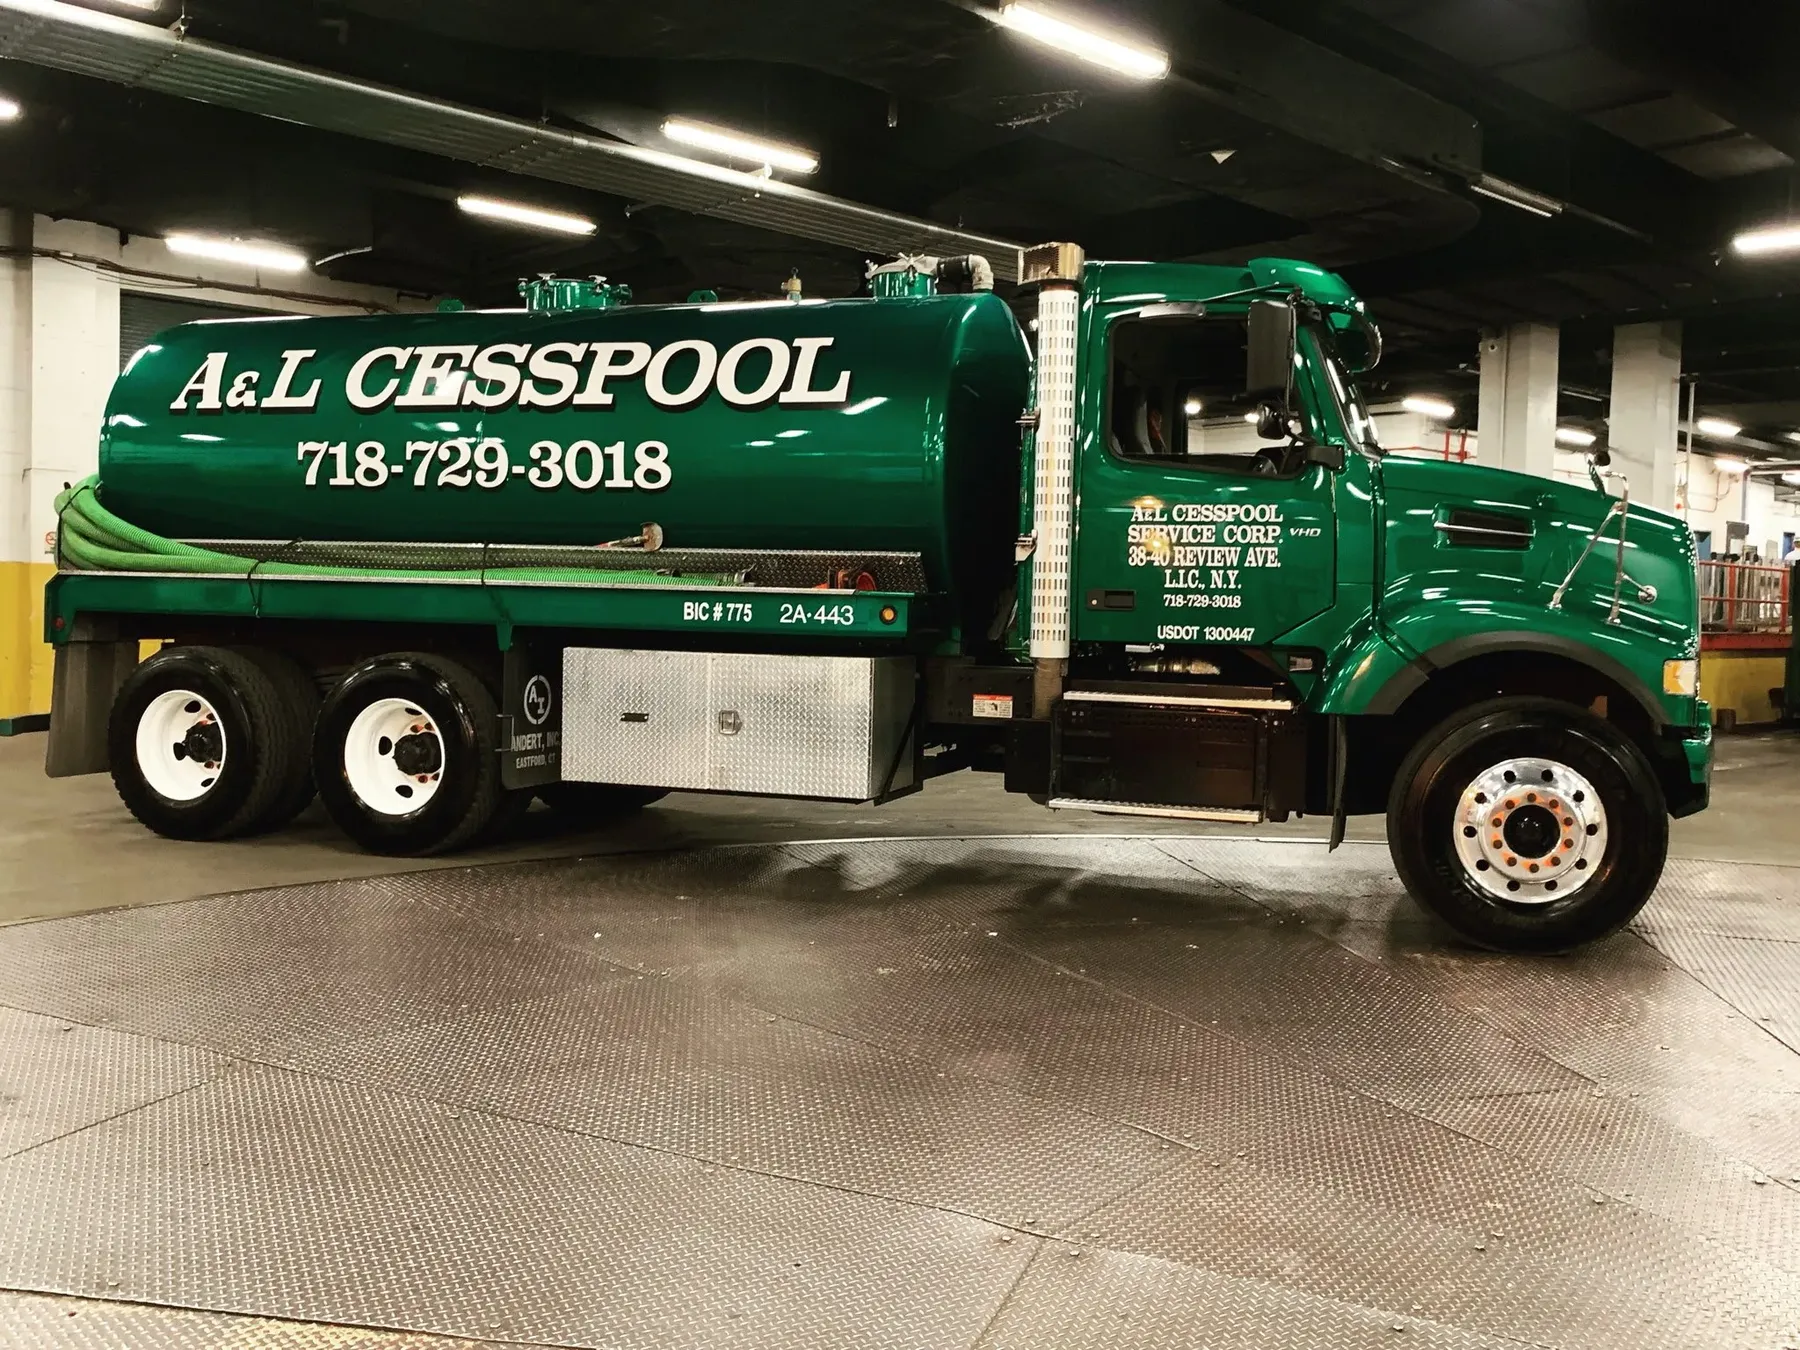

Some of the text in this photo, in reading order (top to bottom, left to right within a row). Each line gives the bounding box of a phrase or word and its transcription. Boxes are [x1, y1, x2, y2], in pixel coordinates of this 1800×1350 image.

[170, 336, 852, 410] A&L CESSPOOL
[297, 440, 673, 490] 718-729-3018
[1172, 504, 1283, 523] CESSPOOL
[1127, 525, 1283, 544] SERVICE CORP.
[1289, 527, 1321, 537] VHD
[1173, 546, 1241, 567] REVIEW
[1244, 547, 1281, 568] AVE.
[1210, 570, 1242, 589] N.Y.
[1163, 594, 1242, 608] 718-729-3018
[683, 601, 752, 622] BIC # 775
[1157, 625, 1255, 641] USDOT 1300447
